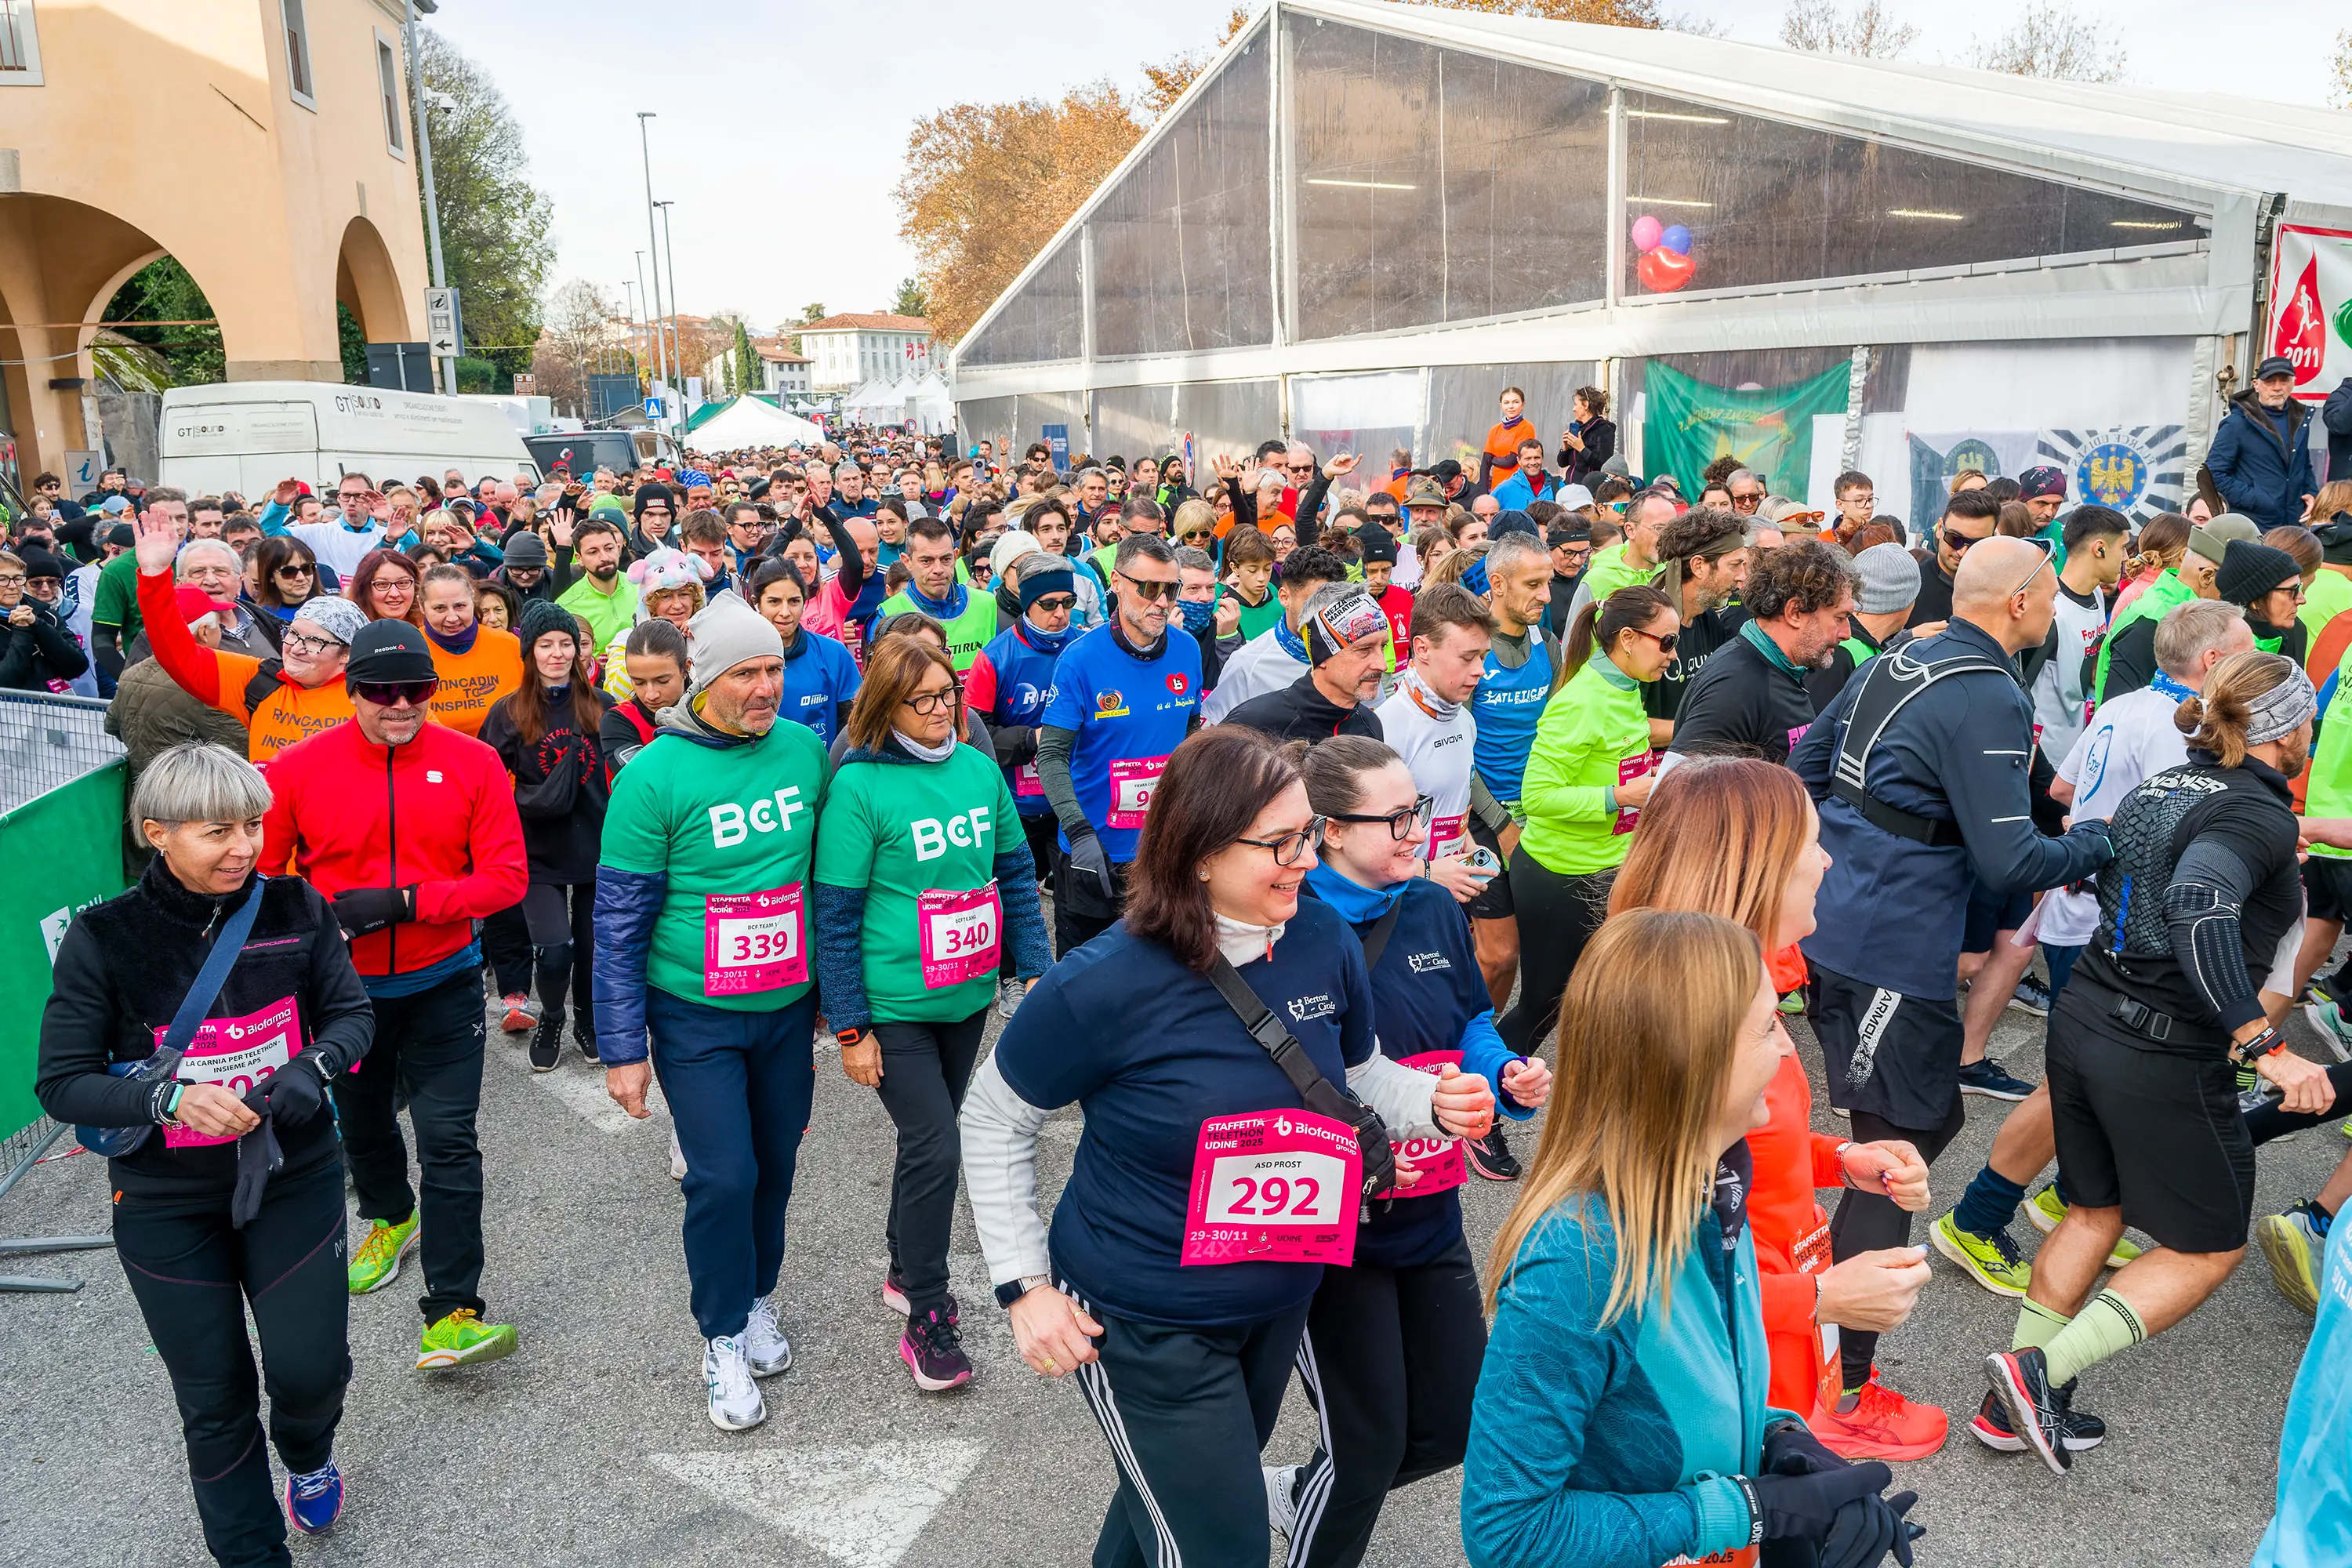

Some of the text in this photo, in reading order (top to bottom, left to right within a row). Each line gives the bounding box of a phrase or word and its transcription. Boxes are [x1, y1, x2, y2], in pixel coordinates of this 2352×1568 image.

[2283, 347, 2319, 368] 2011
[336, 395, 350, 413] GT
[177, 427, 192, 437] GT
[647, 499, 666, 507] MARVEL
[1323, 599, 1348, 619] MEZZA
[1327, 597, 1363, 624] MARATONA
[2082, 629, 2096, 641] For
[374, 645, 397, 654] Reebok
[963, 640, 984, 654] RUN
[430, 698, 486, 712] INSPIRE
[1433, 734, 1464, 748] GIVOVA
[709, 785, 804, 849] BCF
[910, 806, 992, 862] BCF
[771, 891, 800, 906] Biofarma
[946, 921, 989, 954] 340
[733, 931, 788, 960] 339
[1420, 950, 1440, 960] Bertoni
[708, 970, 748, 979] 29-30/11
[925, 962, 959, 973] 29-30/11
[927, 970, 960, 985] 24X1
[709, 978, 749, 992] 24X1
[1303, 992, 1329, 1006] Bertoni
[246, 1008, 292, 1036] Biofarma
[276, 1016, 292, 1028] group
[197, 1058, 227, 1067] CARNIA
[245, 1041, 278, 1059] TELETHON
[213, 1057, 262, 1073] INSIEME APS
[1207, 1118, 1357, 1150] STAFFETTA Biofarma
[1207, 1127, 1265, 1141] TELETHON
[1205, 1138, 1264, 1150] UDINE 2025
[1335, 1144, 1357, 1156] group
[1274, 1160, 1302, 1169] PROST
[1422, 1166, 1437, 1177] DINE
[1227, 1176, 1320, 1216] 292
[1190, 1229, 1249, 1241] 29-30/11
[1793, 1224, 1831, 1254] STAFFETTA
[1189, 1241, 1247, 1258] 24X1
[1795, 1232, 1831, 1265] TELETHON
[1798, 1244, 1832, 1274] UDINE 2025
[1749, 1521, 1763, 1544] UDINE
[1704, 1552, 1734, 1564] 2025
